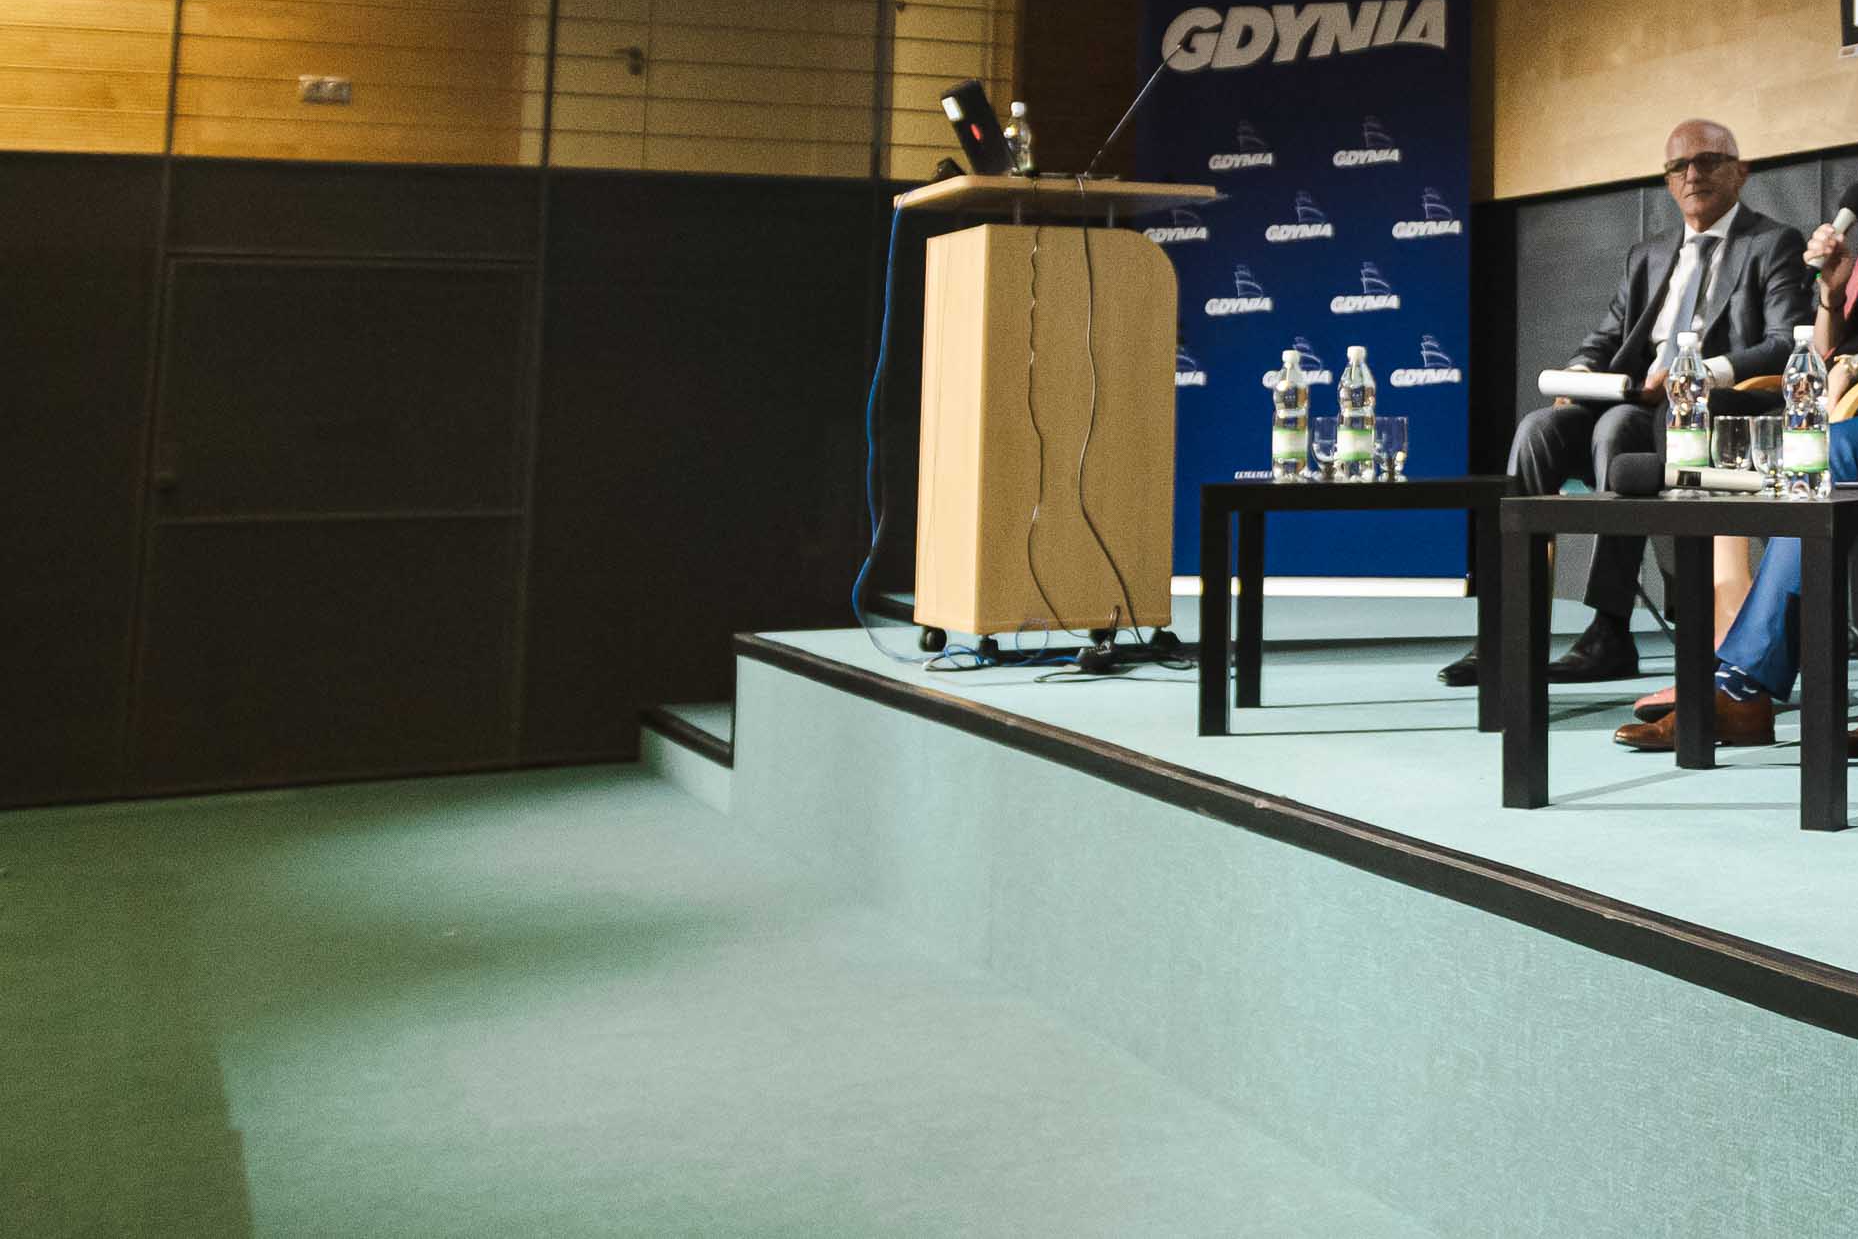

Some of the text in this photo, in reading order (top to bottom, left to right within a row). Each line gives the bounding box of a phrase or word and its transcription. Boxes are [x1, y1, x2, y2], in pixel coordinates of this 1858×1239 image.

[1208, 152, 1273, 170] GDYNIA
[1333, 149, 1400, 167] GDYNIA
[1265, 223, 1333, 242] GDYNIA
[1392, 220, 1462, 239] GDYNIA
[1204, 297, 1272, 316] GDYNIA
[1330, 295, 1400, 314] GDYNIA
[1390, 368, 1461, 387] GDYNIA
